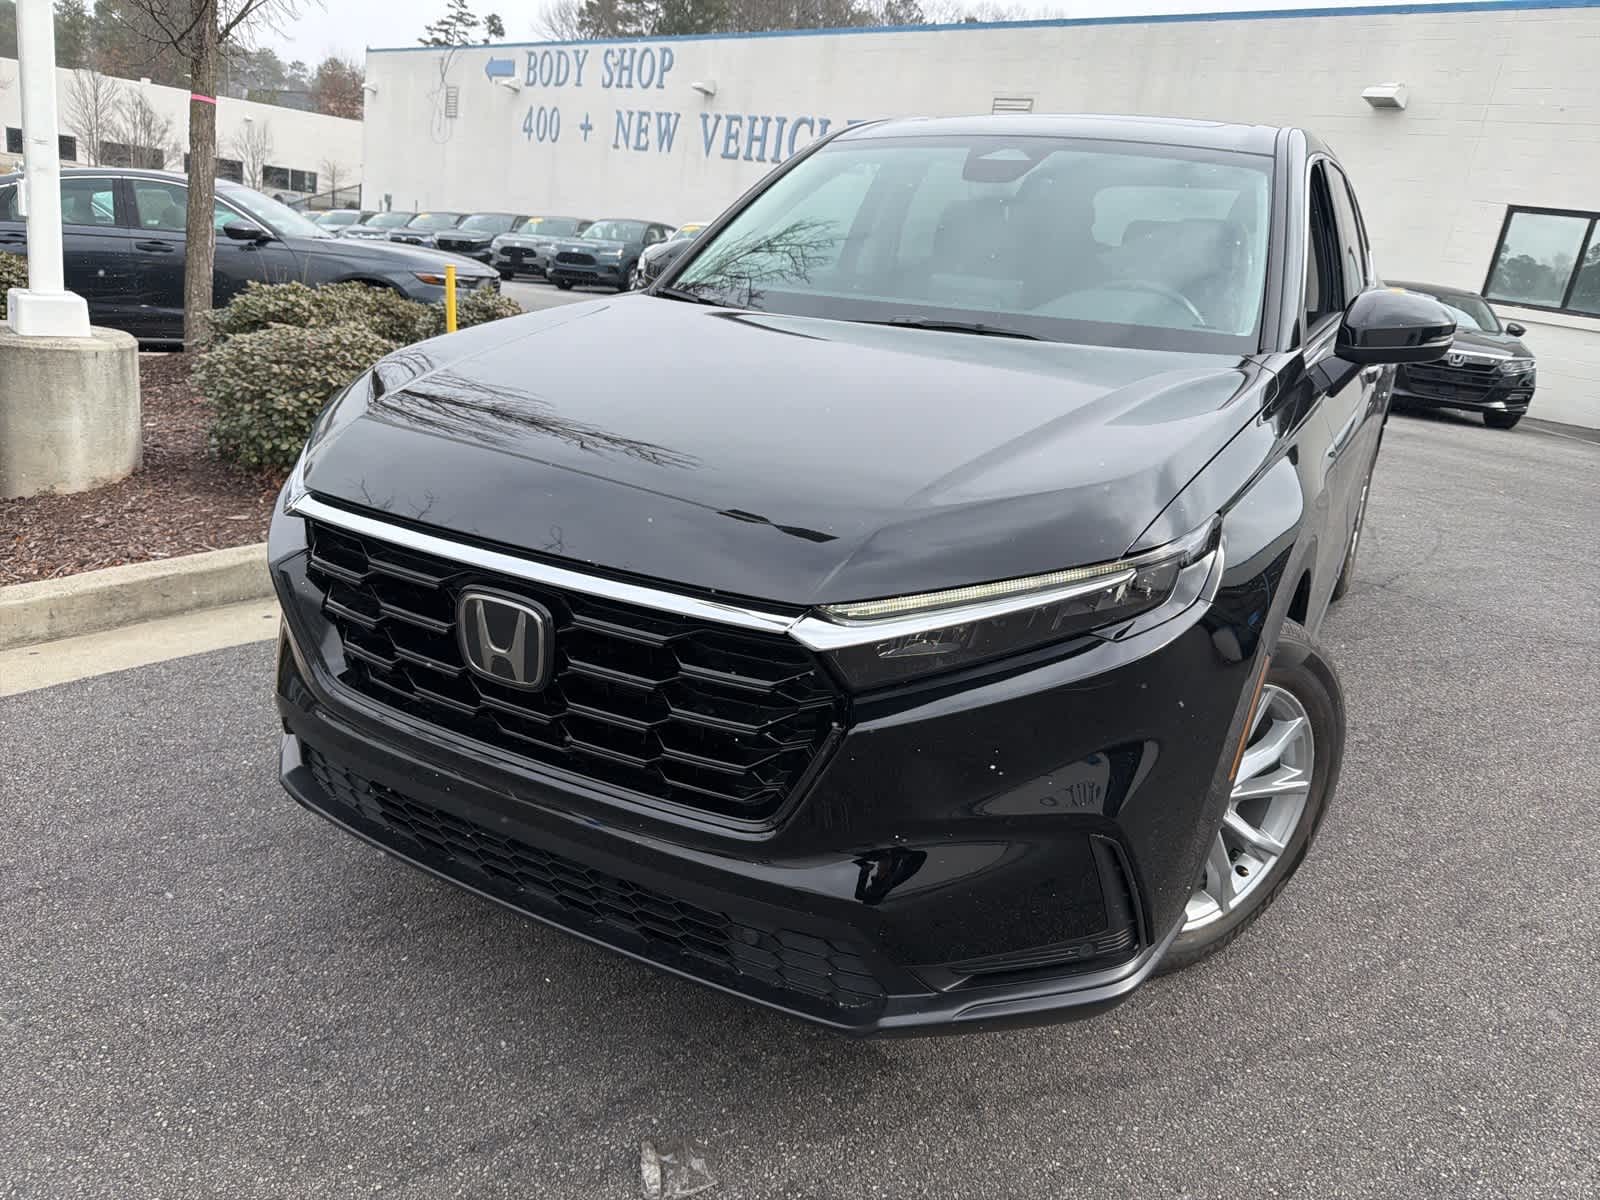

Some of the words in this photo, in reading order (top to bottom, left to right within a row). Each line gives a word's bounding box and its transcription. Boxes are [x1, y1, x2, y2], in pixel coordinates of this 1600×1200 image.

[525, 49, 589, 88] BODY
[601, 46, 674, 89] SHOP
[522, 106, 560, 143] 400
[612, 109, 680, 153] NEW
[700, 112, 866, 164] VEHIC
